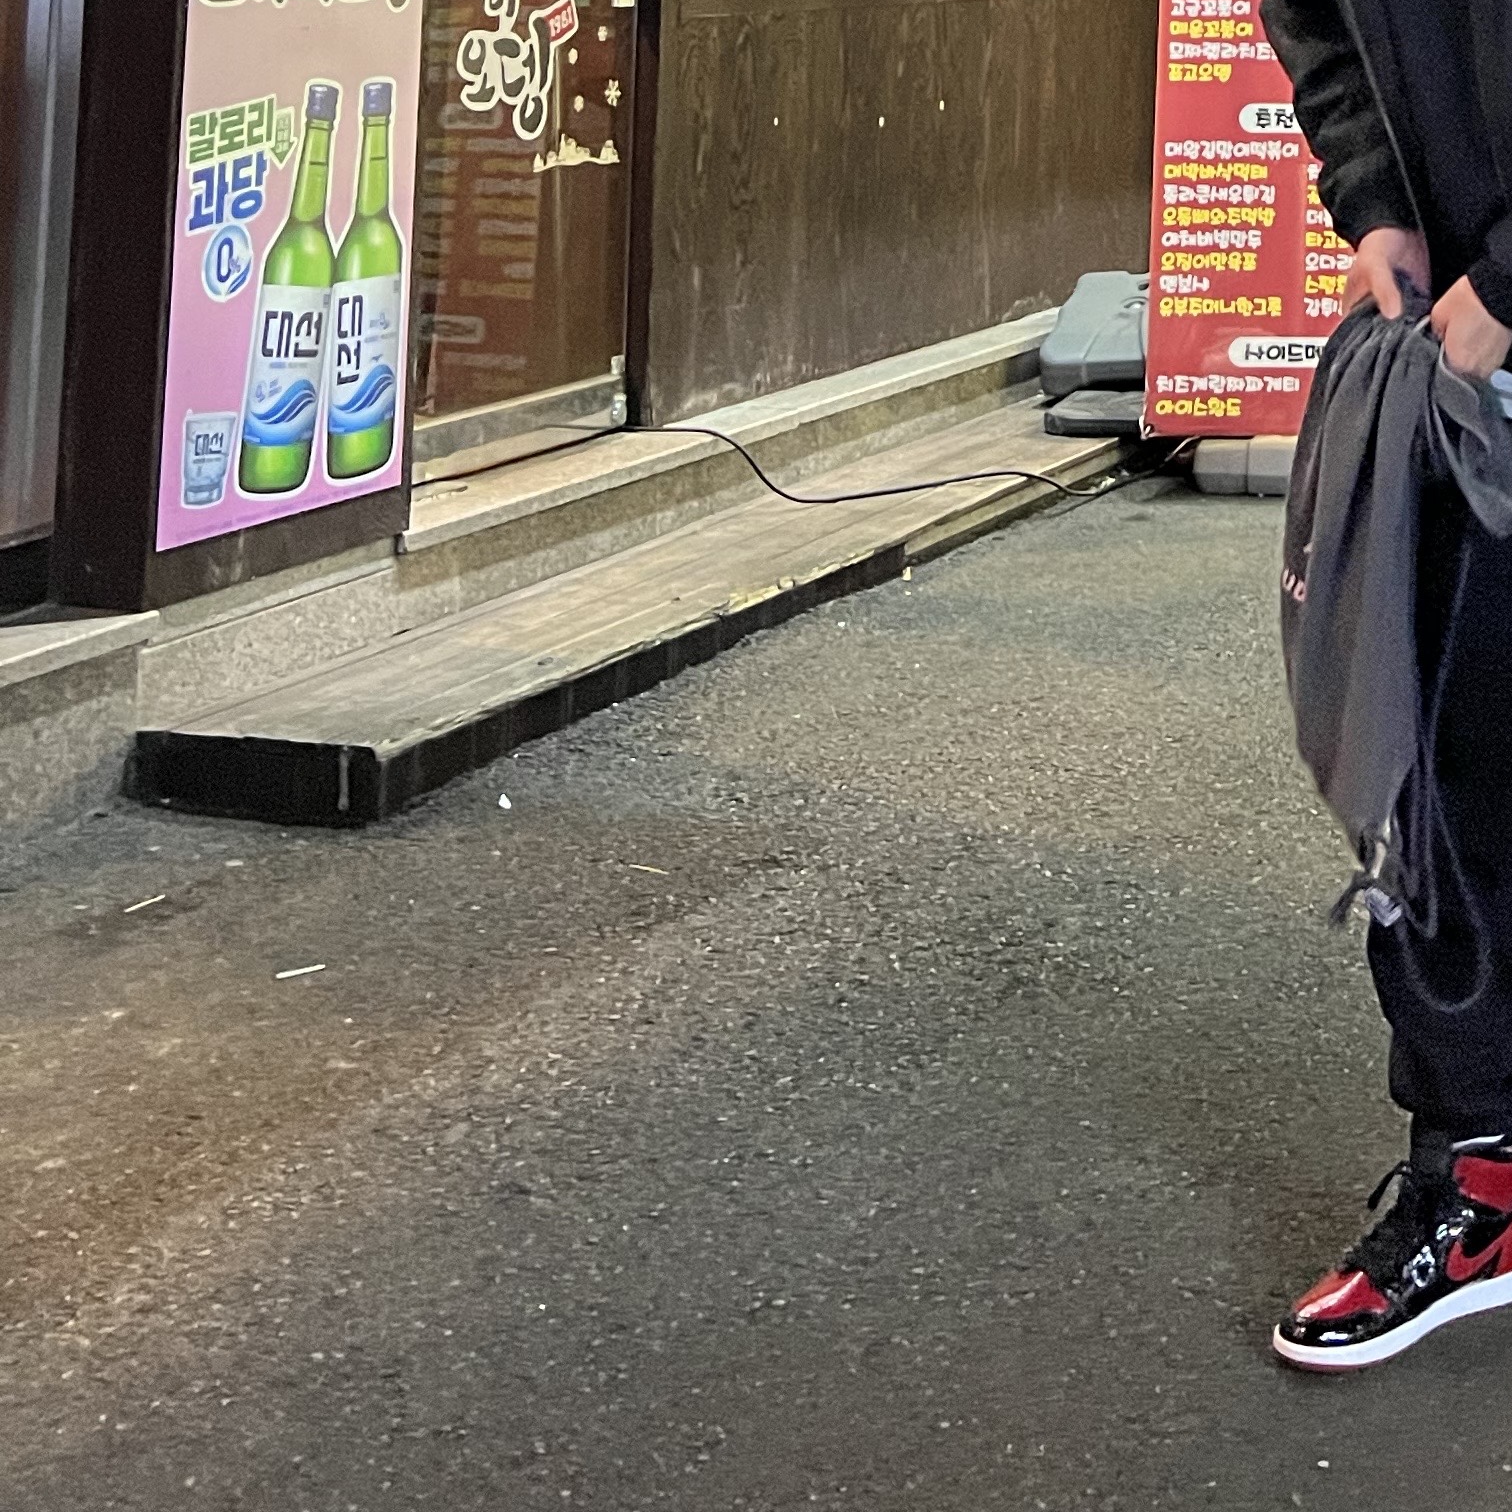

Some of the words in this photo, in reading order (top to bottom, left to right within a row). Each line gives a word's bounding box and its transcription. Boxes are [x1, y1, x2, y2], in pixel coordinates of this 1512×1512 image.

[549, 5, 574, 36] 1981
[189, 97, 274, 165] 칼로리
[189, 150, 268, 231] 과당
[261, 310, 323, 359] 대선
